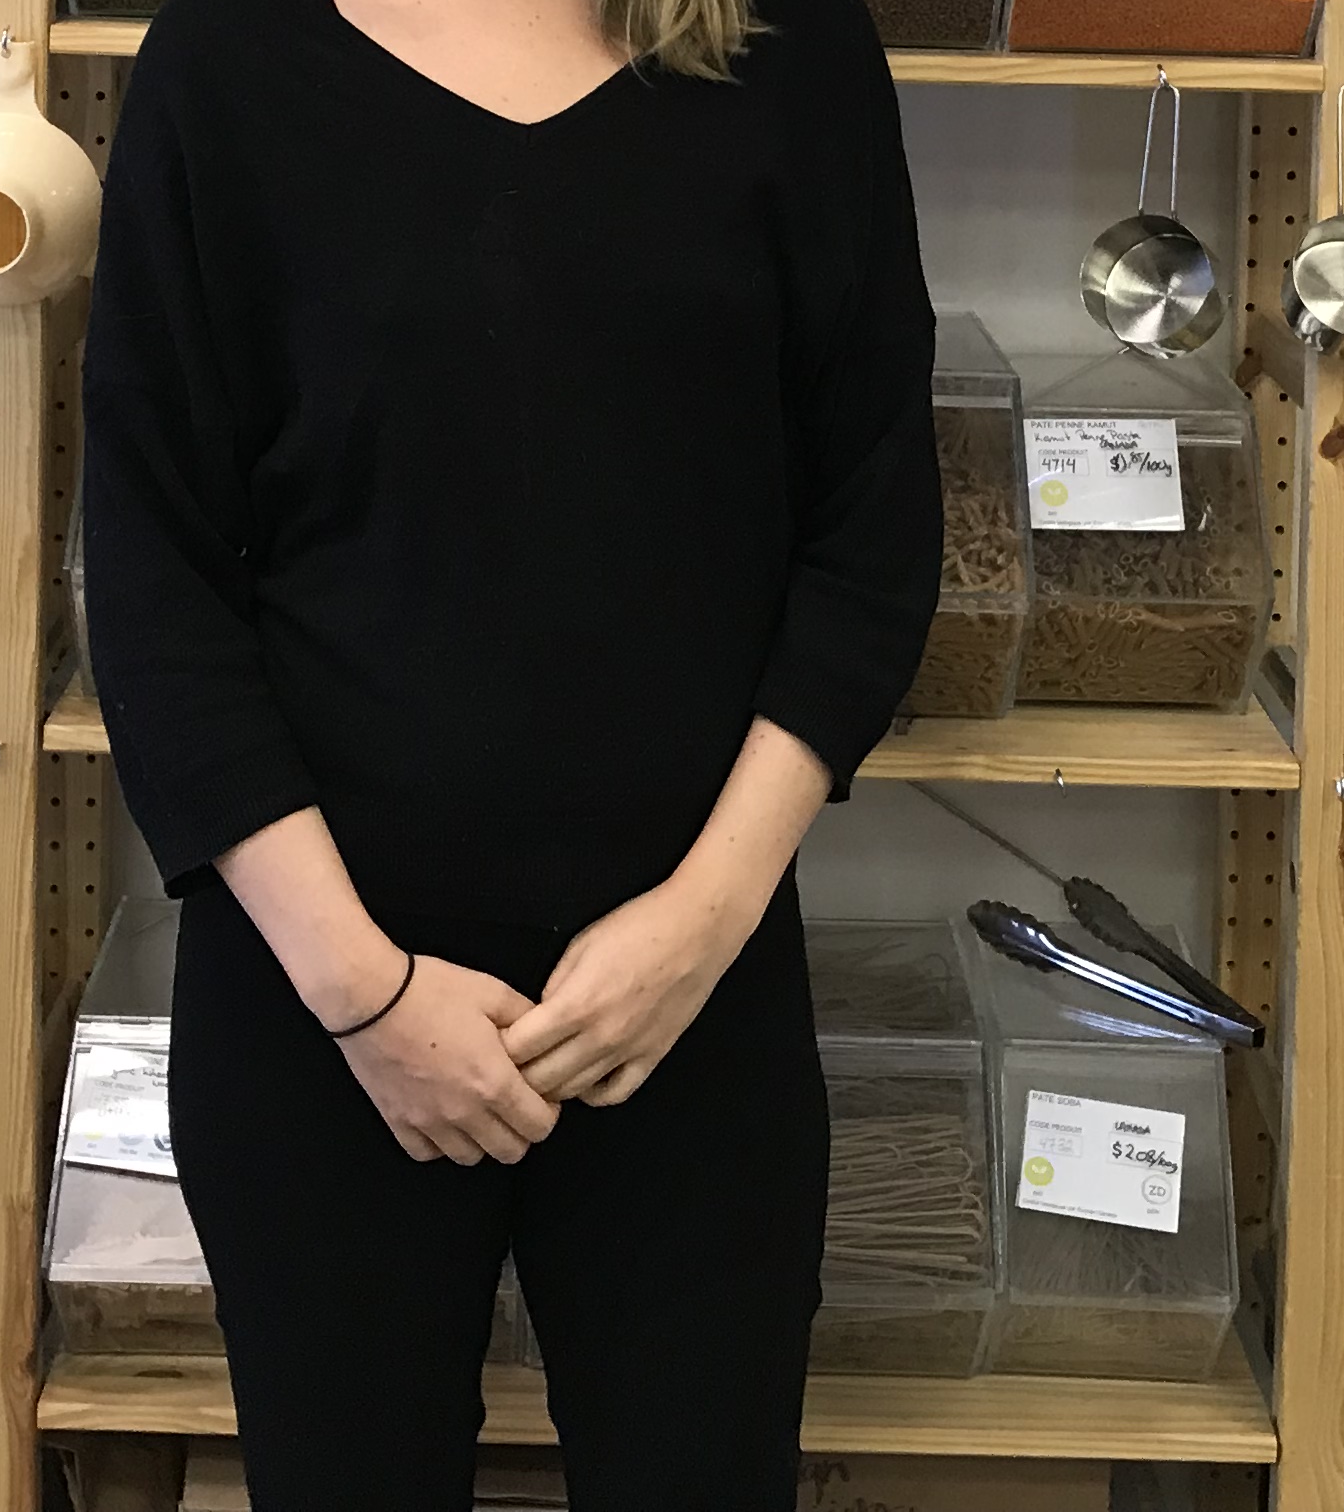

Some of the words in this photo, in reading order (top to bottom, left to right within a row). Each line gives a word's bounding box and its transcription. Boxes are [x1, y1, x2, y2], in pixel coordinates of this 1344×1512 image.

[1055, 421, 1084, 429] PENNE
[1087, 421, 1117, 429] KAMUT
[1041, 457, 1076, 474] 4714
[1057, 1096, 1082, 1108] SOBA
[1029, 1120, 1050, 1129] CODE
[1051, 1124, 1083, 1133] PRODUIT
[1148, 1184, 1167, 1197] ZD
